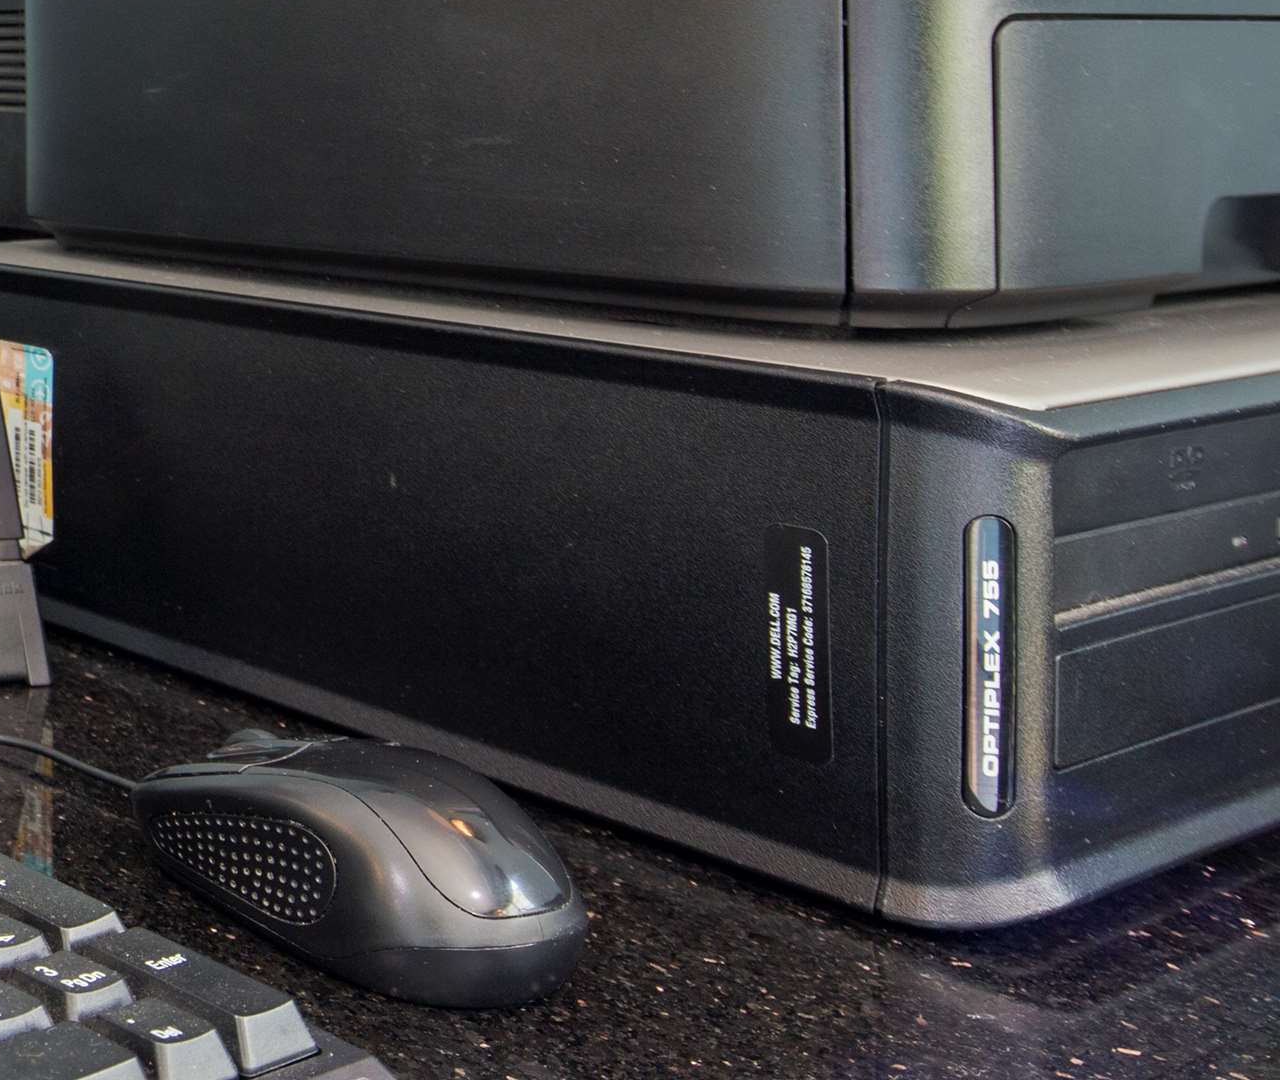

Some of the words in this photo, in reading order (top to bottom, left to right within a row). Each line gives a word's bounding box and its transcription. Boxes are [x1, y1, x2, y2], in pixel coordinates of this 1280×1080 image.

[982, 559, 1000, 618] 755
[768, 591, 783, 680] WWW.DELL.COM
[802, 616, 814, 646] Code:
[788, 660, 801, 684] Tag:
[803, 647, 816, 687] Service
[789, 686, 801, 726] Service
[804, 687, 818, 730] Express
[982, 630, 1001, 777] OPTIPLEX
[34, 965, 58, 977] 3
[145, 953, 188, 971] Enter
[150, 1025, 184, 1040] Del
